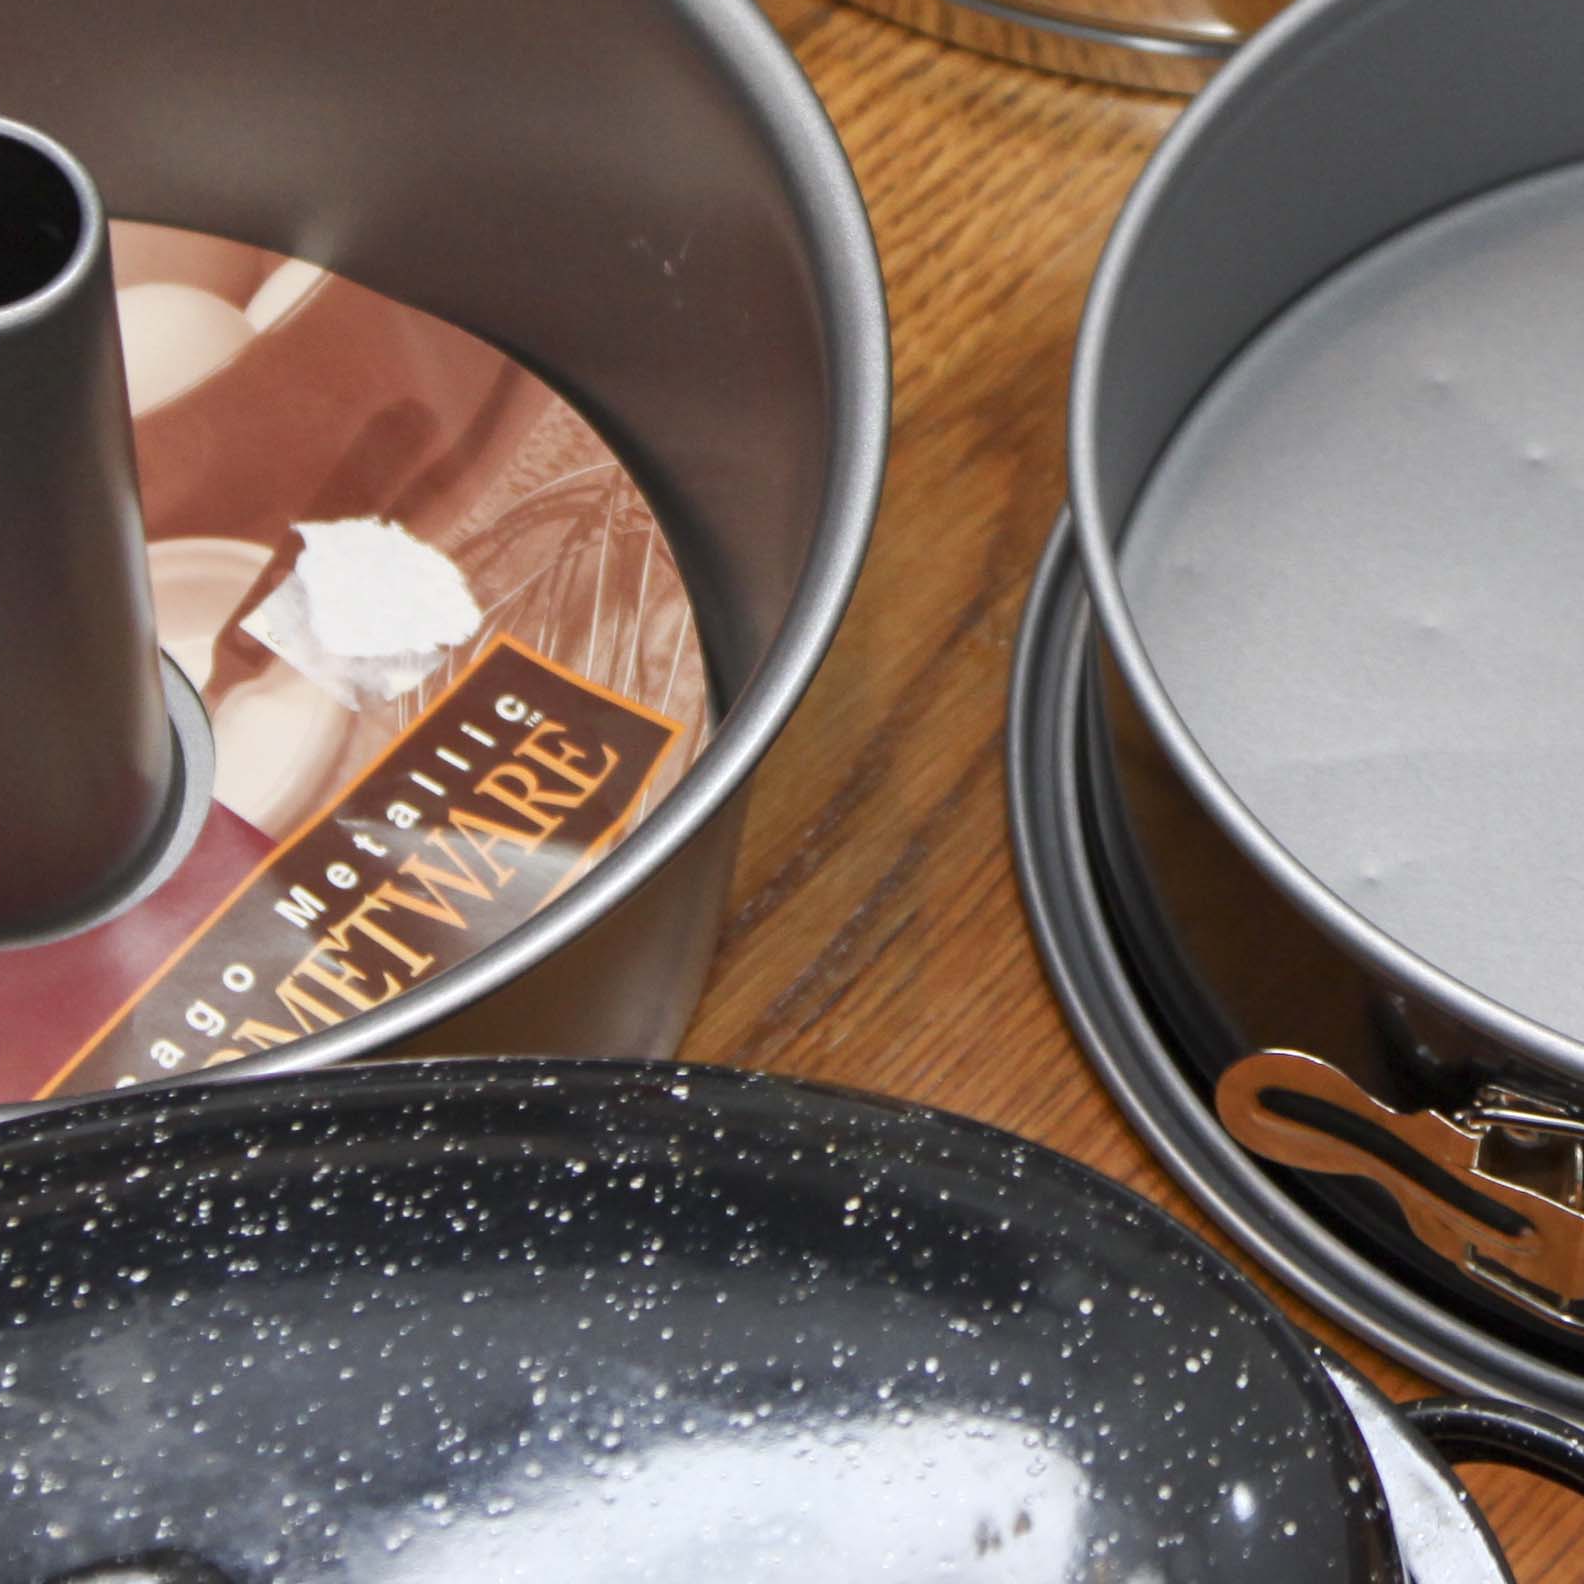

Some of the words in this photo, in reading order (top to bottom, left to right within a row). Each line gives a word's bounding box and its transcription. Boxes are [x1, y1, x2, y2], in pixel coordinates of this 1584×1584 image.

[115, 964, 255, 1089] ago
[274, 694, 527, 928] Metallic
[201, 719, 620, 1068] METWARE
